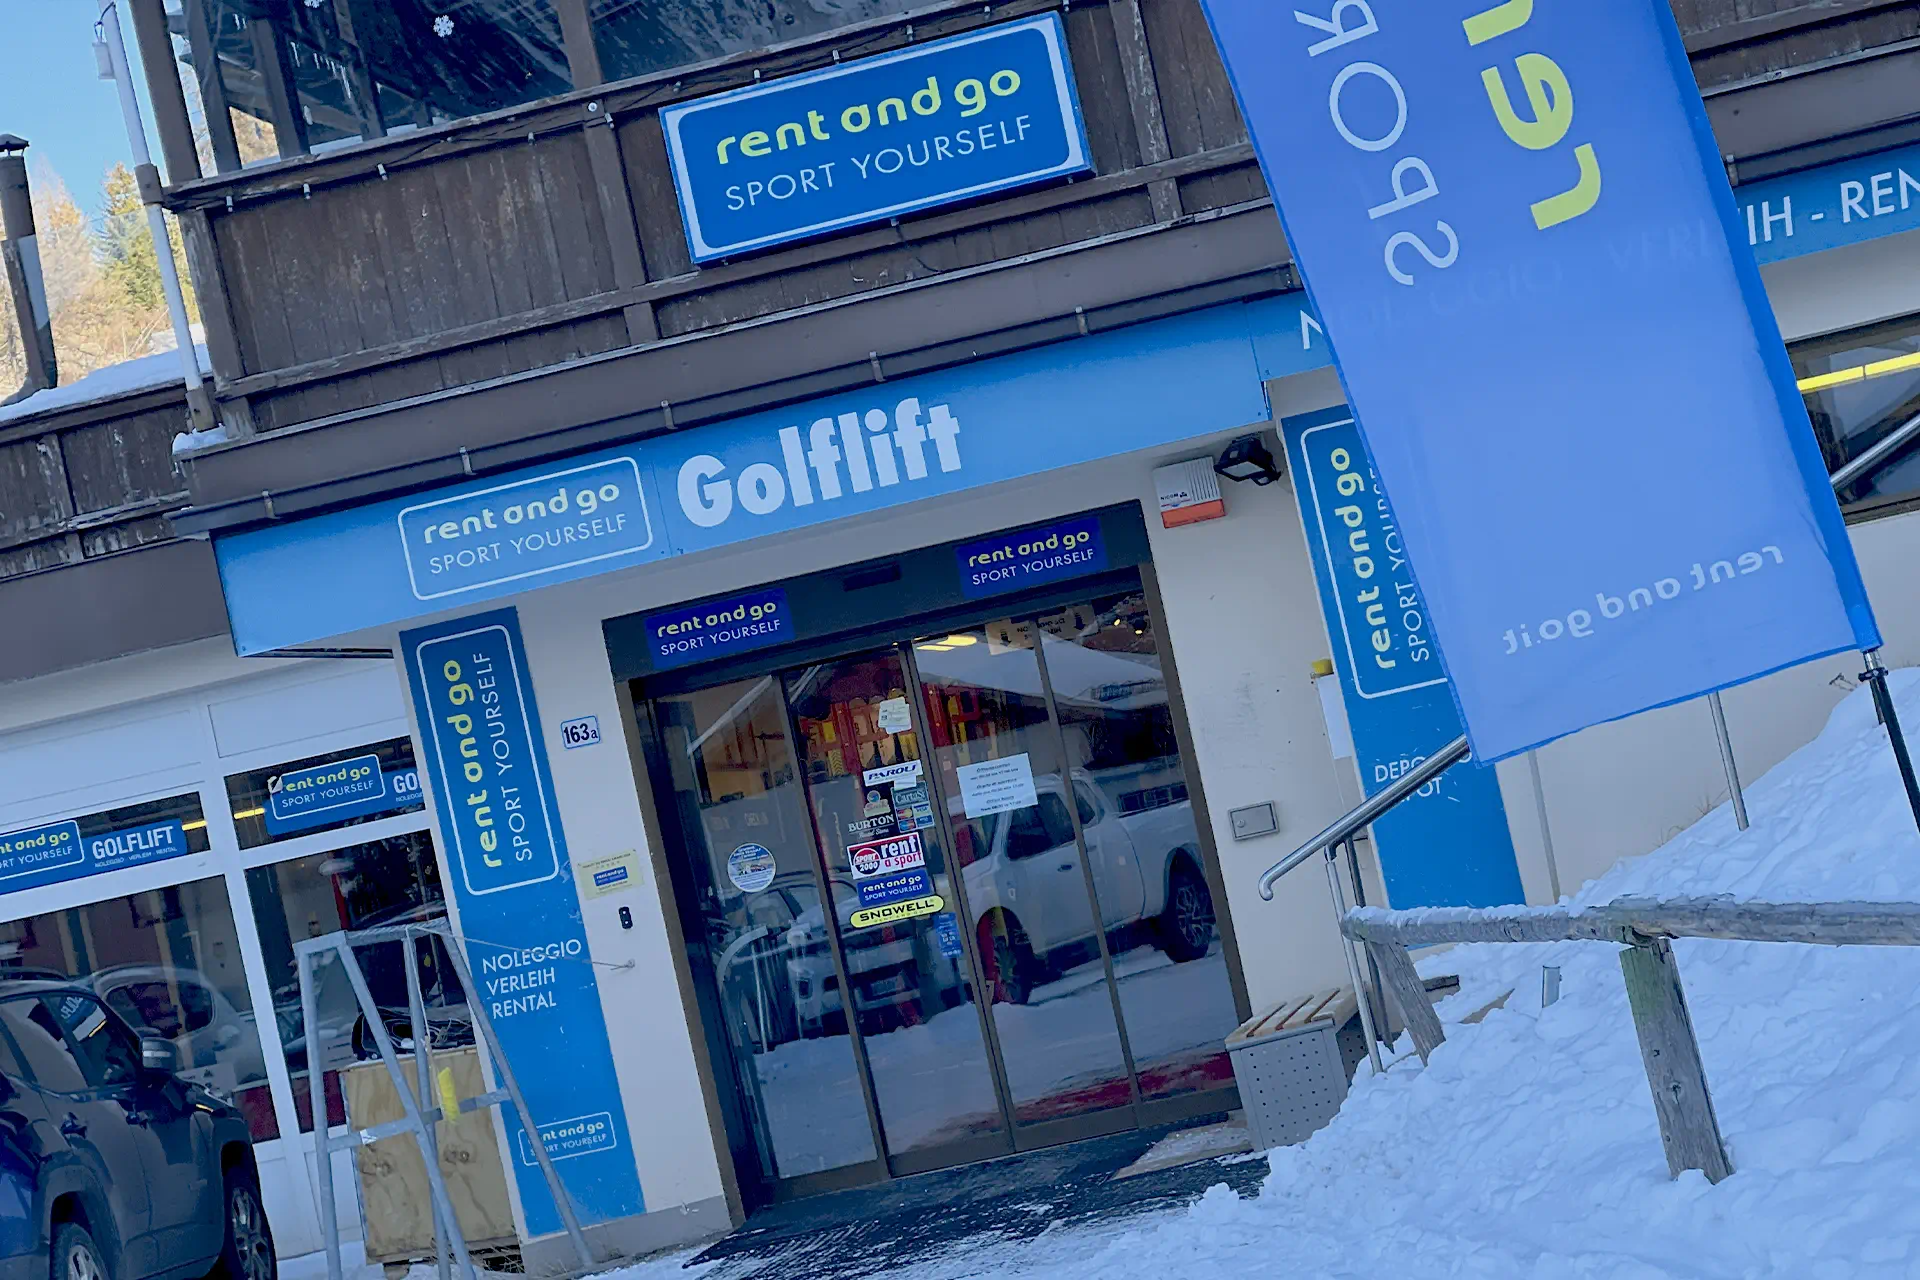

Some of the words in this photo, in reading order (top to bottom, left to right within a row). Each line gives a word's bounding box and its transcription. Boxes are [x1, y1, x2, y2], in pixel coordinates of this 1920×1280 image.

[716, 110, 830, 164] rent
[840, 76, 942, 133] and
[953, 69, 1021, 118] go
[725, 162, 836, 211] SPORT
[851, 115, 1032, 179] YOURSELF
[677, 397, 962, 528] Golflift
[1330, 447, 1365, 497] go
[423, 508, 498, 544] rent
[503, 487, 569, 524] and
[576, 484, 620, 516] go
[429, 543, 501, 574] SPORT
[510, 513, 627, 555] YOURSELF
[967, 546, 1014, 567] rent
[1018, 533, 1058, 555] and
[1062, 531, 1089, 551] go
[1334, 505, 1375, 579] and
[972, 566, 1017, 585] SPORT
[1021, 548, 1094, 574] YOURSELF
[657, 616, 702, 638] rent
[705, 604, 746, 626] and
[749, 602, 777, 621] go
[660, 636, 704, 656] SPORT
[709, 619, 781, 644] YOURSELF
[1356, 586, 1396, 669] rent
[1394, 581, 1430, 662] SPORT
[443, 659, 475, 706] go
[472, 652, 513, 776] YOURSELF
[446, 713, 484, 783] and
[563, 723, 599, 744] 163a
[281, 793, 316, 808] SPORT
[320, 780, 374, 799] YOURSELF
[284, 776, 314, 793] ent
[316, 768, 348, 786] and
[350, 766, 371, 781] go
[15, 833, 46, 850] and
[49, 831, 71, 847] go
[466, 789, 502, 868] rent
[500, 785, 533, 862] SPORT
[848, 814, 895, 832] BURTON
[18, 846, 73, 864] YOURSELF
[92, 826, 174, 860] GOLFLIFT
[855, 854, 876, 864] SPORT
[880, 835, 917, 858] rent
[884, 859, 891, 868] a
[894, 852, 922, 868] sport
[859, 861, 879, 872] 2000
[863, 882, 886, 893] rent
[886, 877, 907, 888] and
[908, 875, 921, 885] go
[864, 891, 886, 901] SPORT
[888, 883, 923, 896] YOURSELF
[859, 900, 934, 922] SNOWELL
[482, 939, 582, 974] NOLEGGIO
[486, 967, 556, 996] VERLEIH
[492, 991, 557, 1020] RENTAL
[559, 1123, 585, 1138] and
[587, 1121, 604, 1135] go
[561, 1132, 607, 1150] YOURSELF
